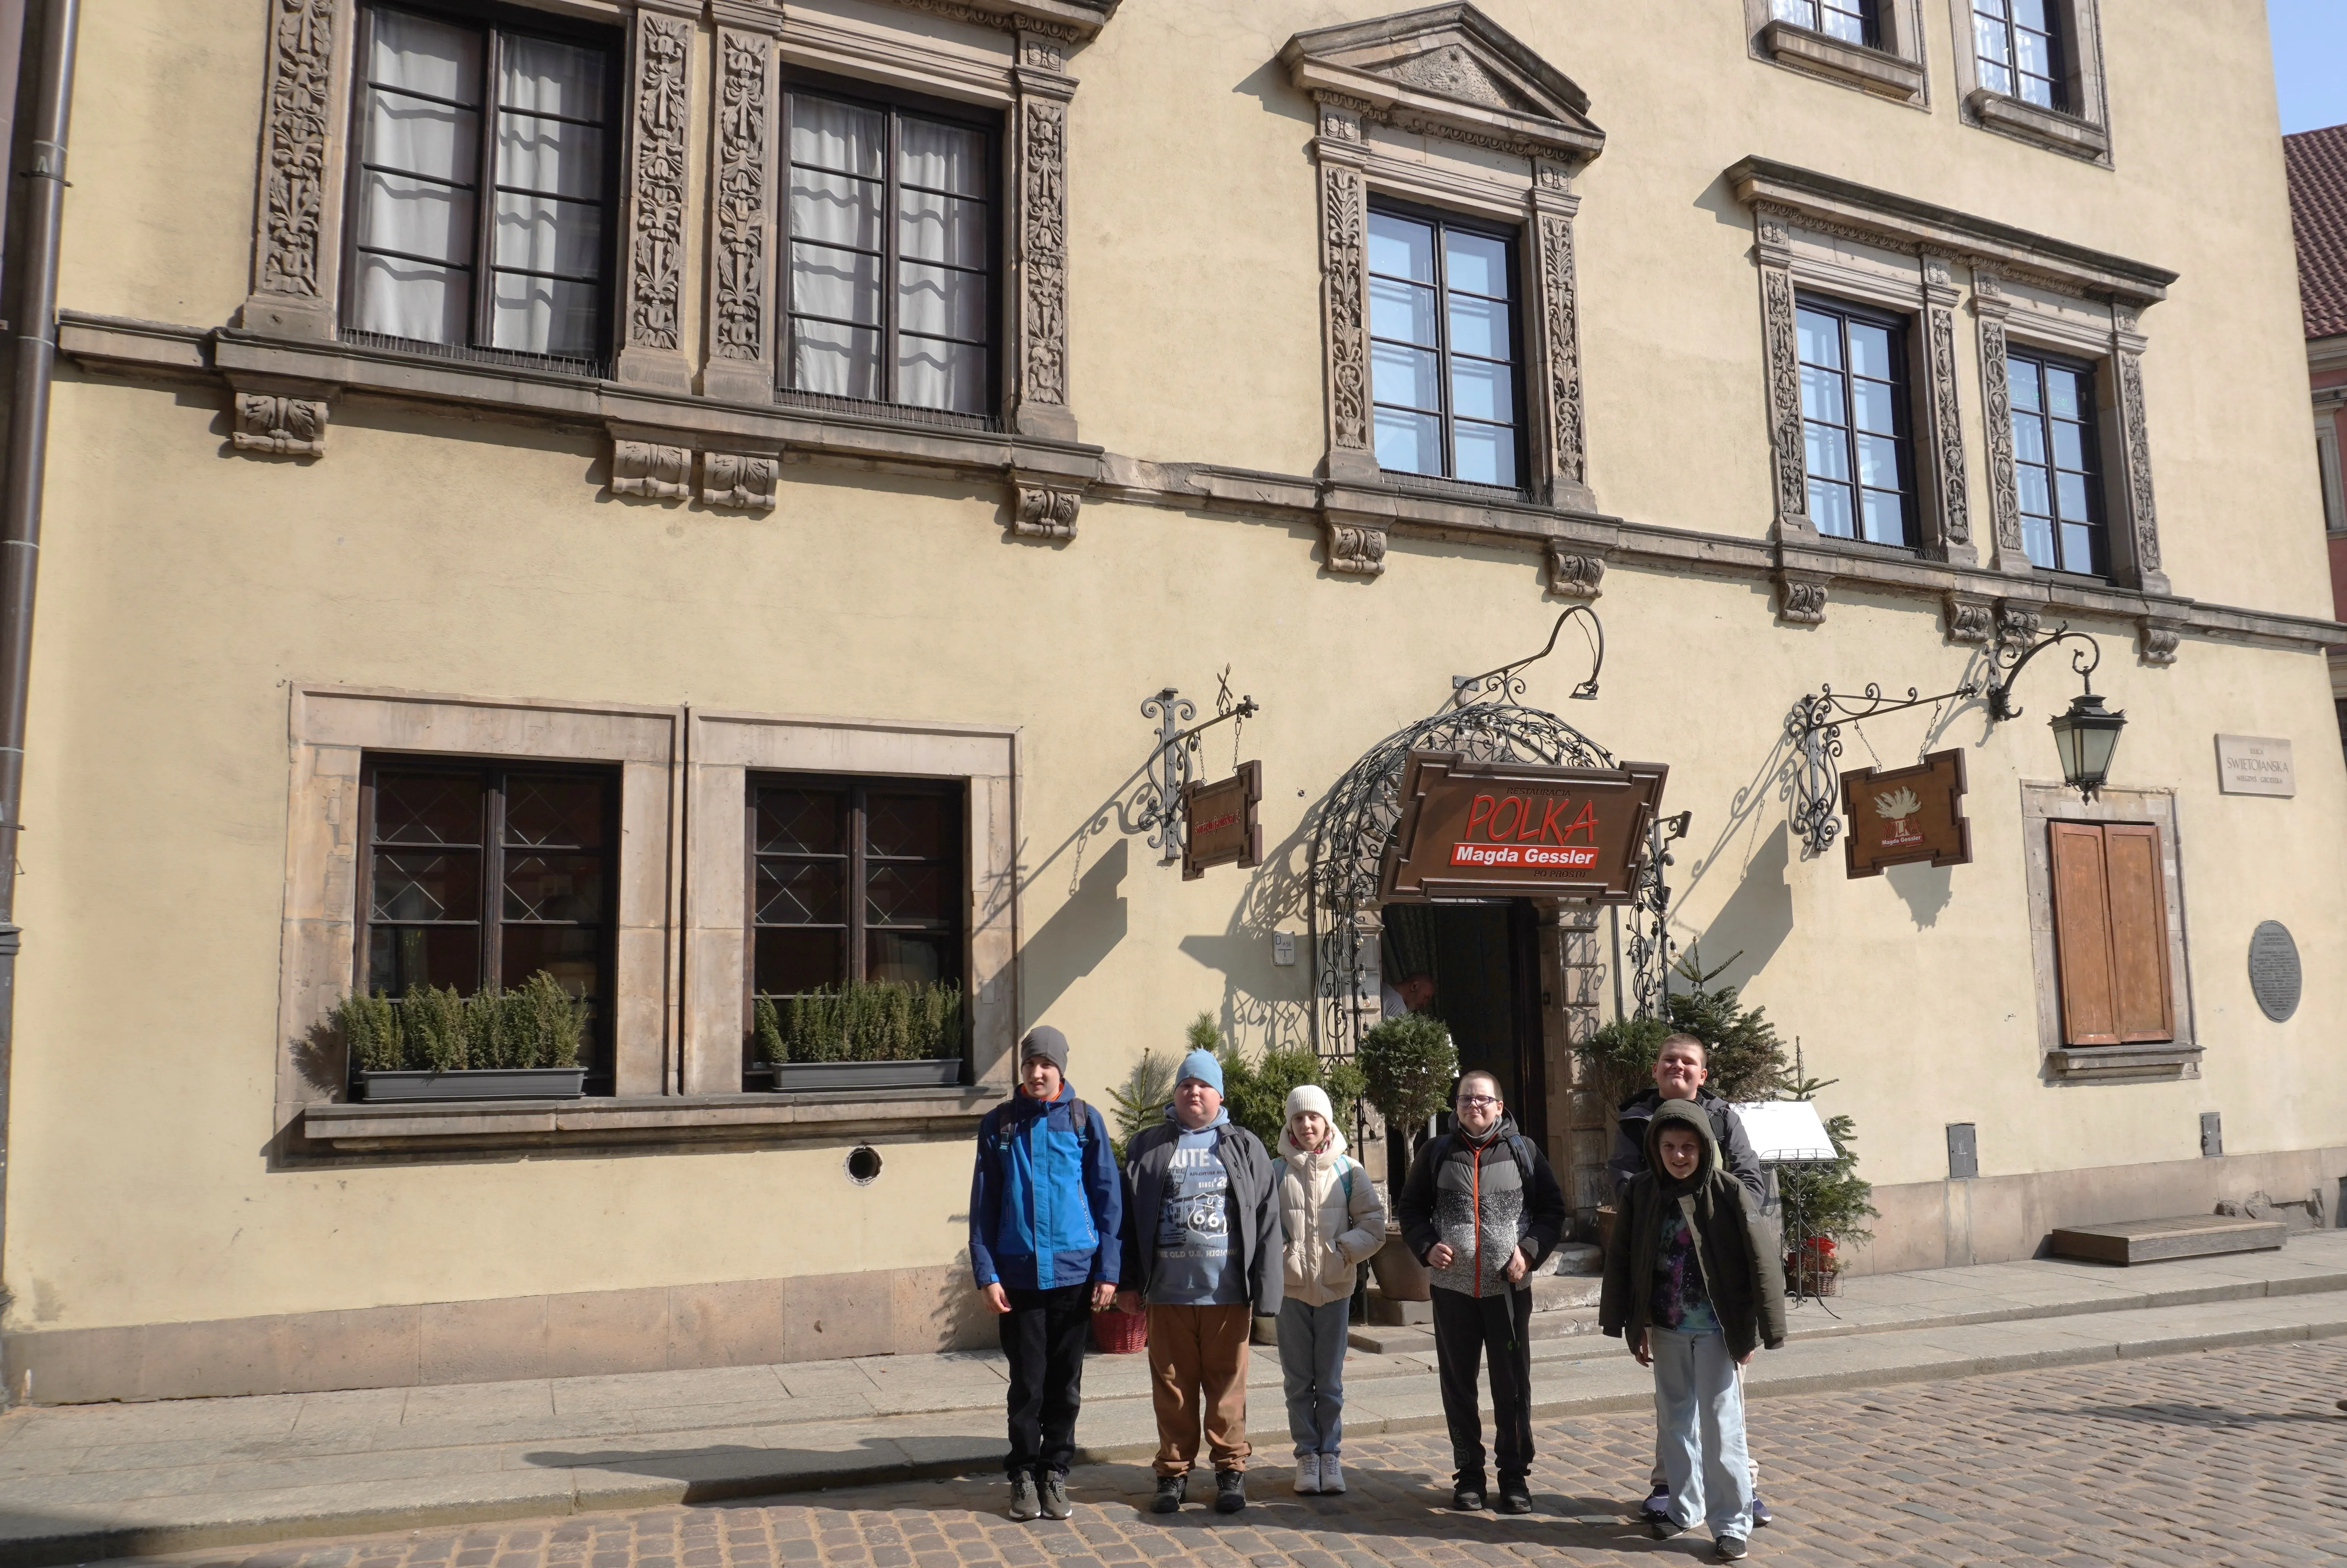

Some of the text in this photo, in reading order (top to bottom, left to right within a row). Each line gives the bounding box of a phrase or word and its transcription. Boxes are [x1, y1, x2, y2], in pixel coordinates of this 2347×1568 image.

[1507, 787, 1571, 797] RESTAURACJA
[1235, 809, 1241, 824] 2
[1465, 794, 1599, 845] POLKA
[1883, 818, 1921, 839] POLKA
[1456, 846, 1594, 865] Magda Gessler
[1275, 935, 1281, 945] D
[1168, 1148, 1211, 1168] UTE
